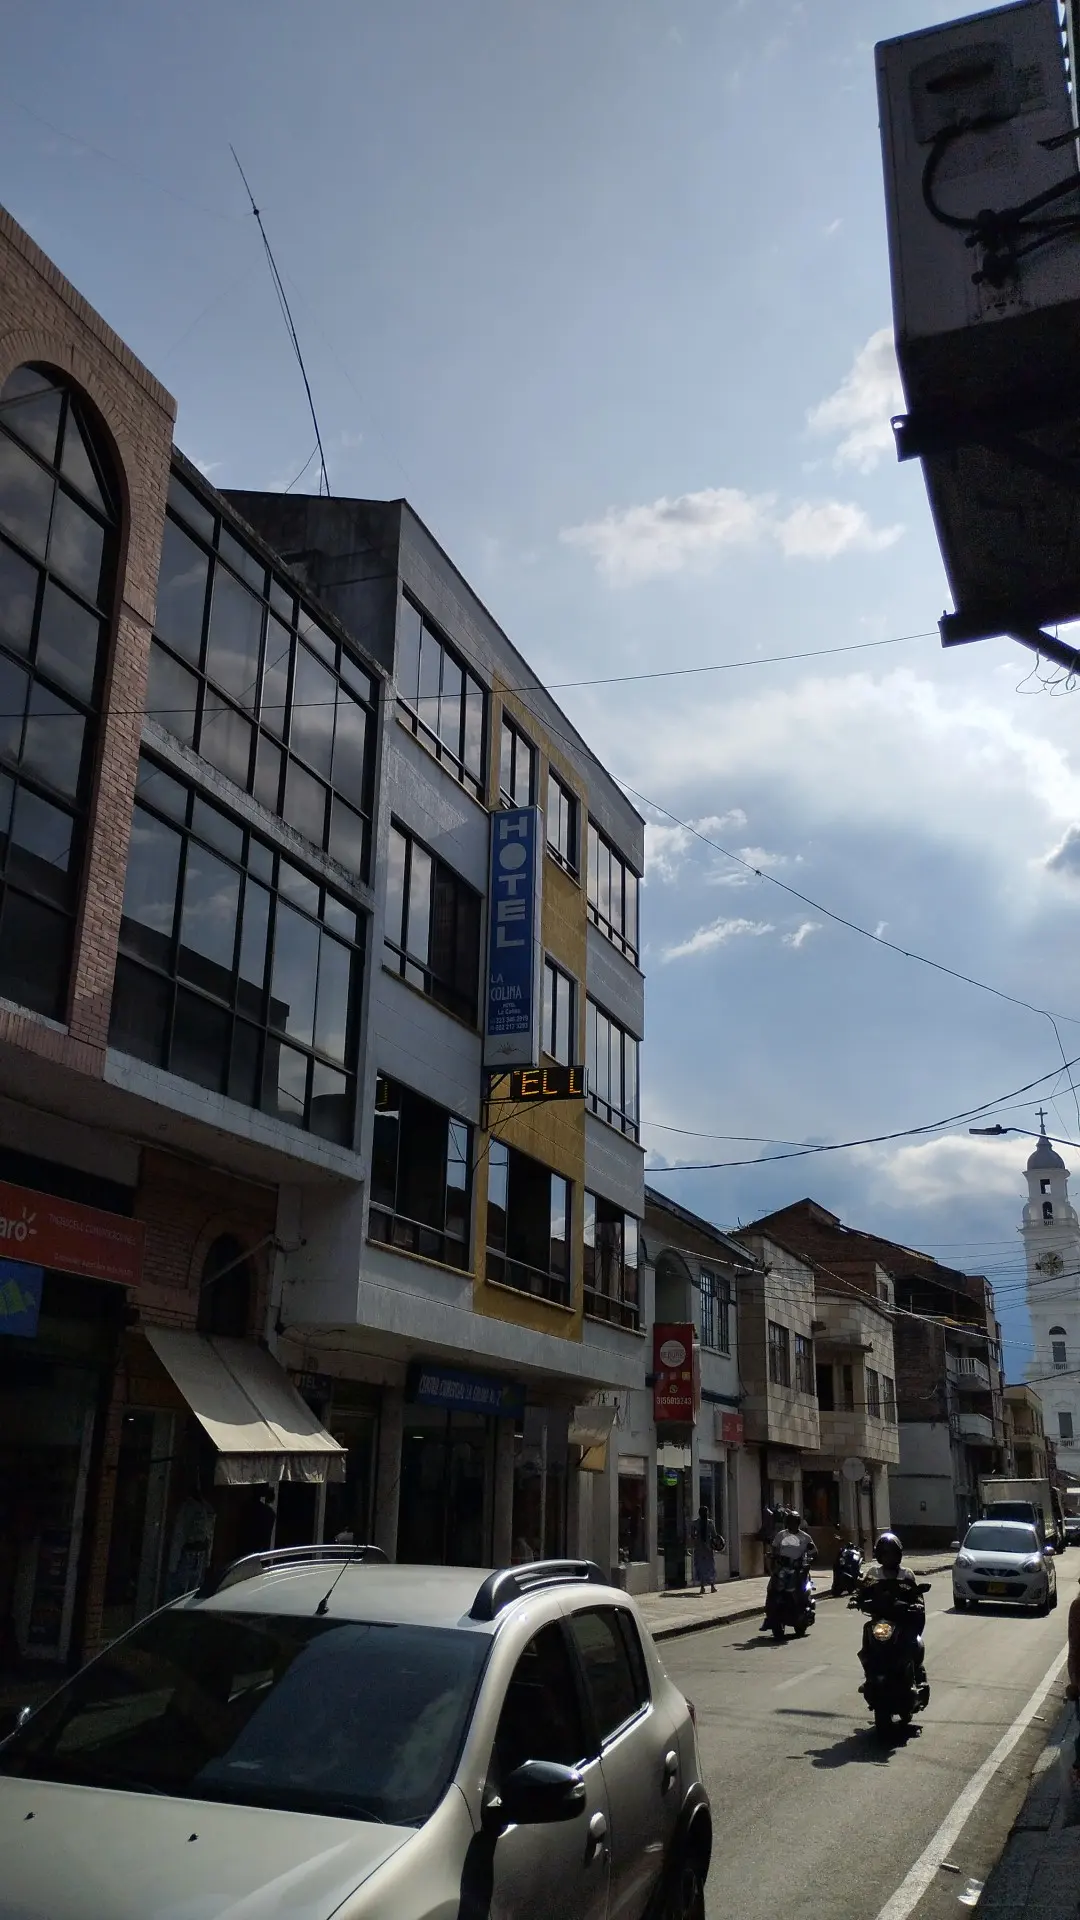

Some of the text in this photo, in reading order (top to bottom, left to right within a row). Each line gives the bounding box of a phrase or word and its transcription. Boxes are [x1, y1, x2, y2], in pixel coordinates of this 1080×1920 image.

[496, 816, 528, 948] HOTEL
[491, 973, 504, 984] LA
[490, 985, 522, 1001] COLINA
[569, 1068, 582, 1094] L
